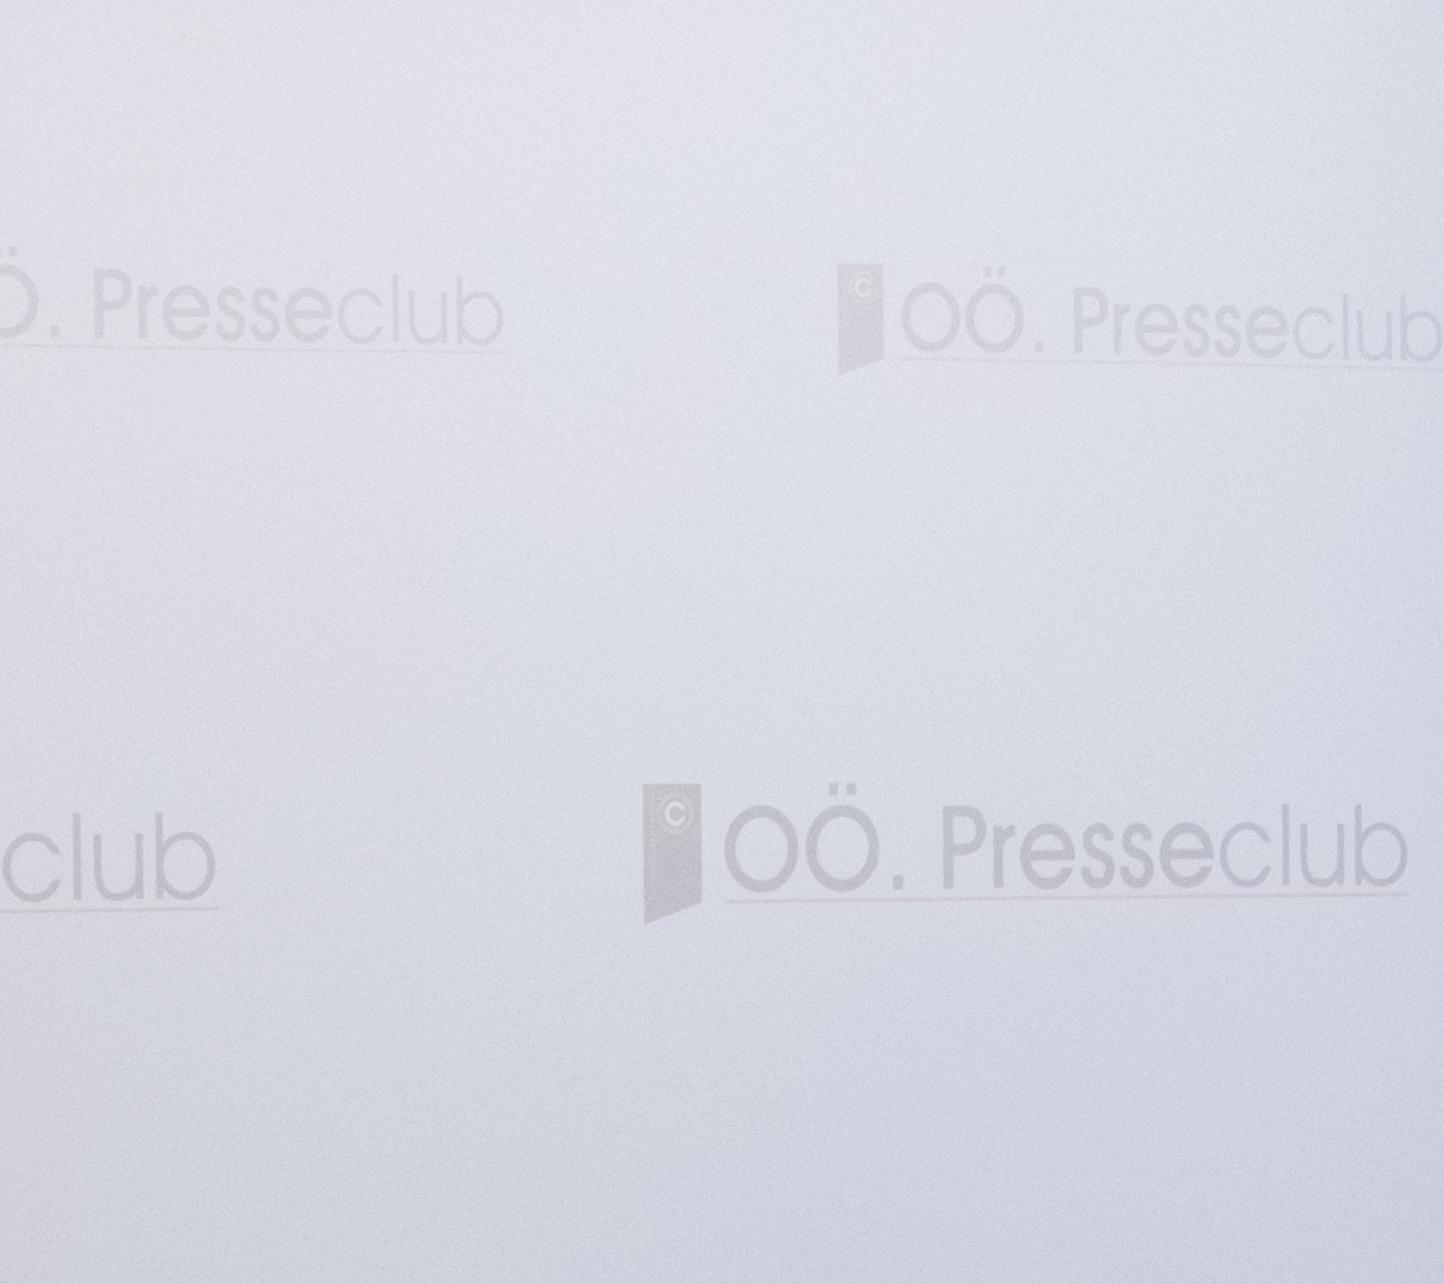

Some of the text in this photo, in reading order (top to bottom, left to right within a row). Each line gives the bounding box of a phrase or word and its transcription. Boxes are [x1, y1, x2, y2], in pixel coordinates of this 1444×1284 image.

[92, 267, 504, 346] Presseclub
[902, 266, 1443, 363] OÖ. Presseclub
[724, 782, 1408, 893] OÖ. Presseclub
